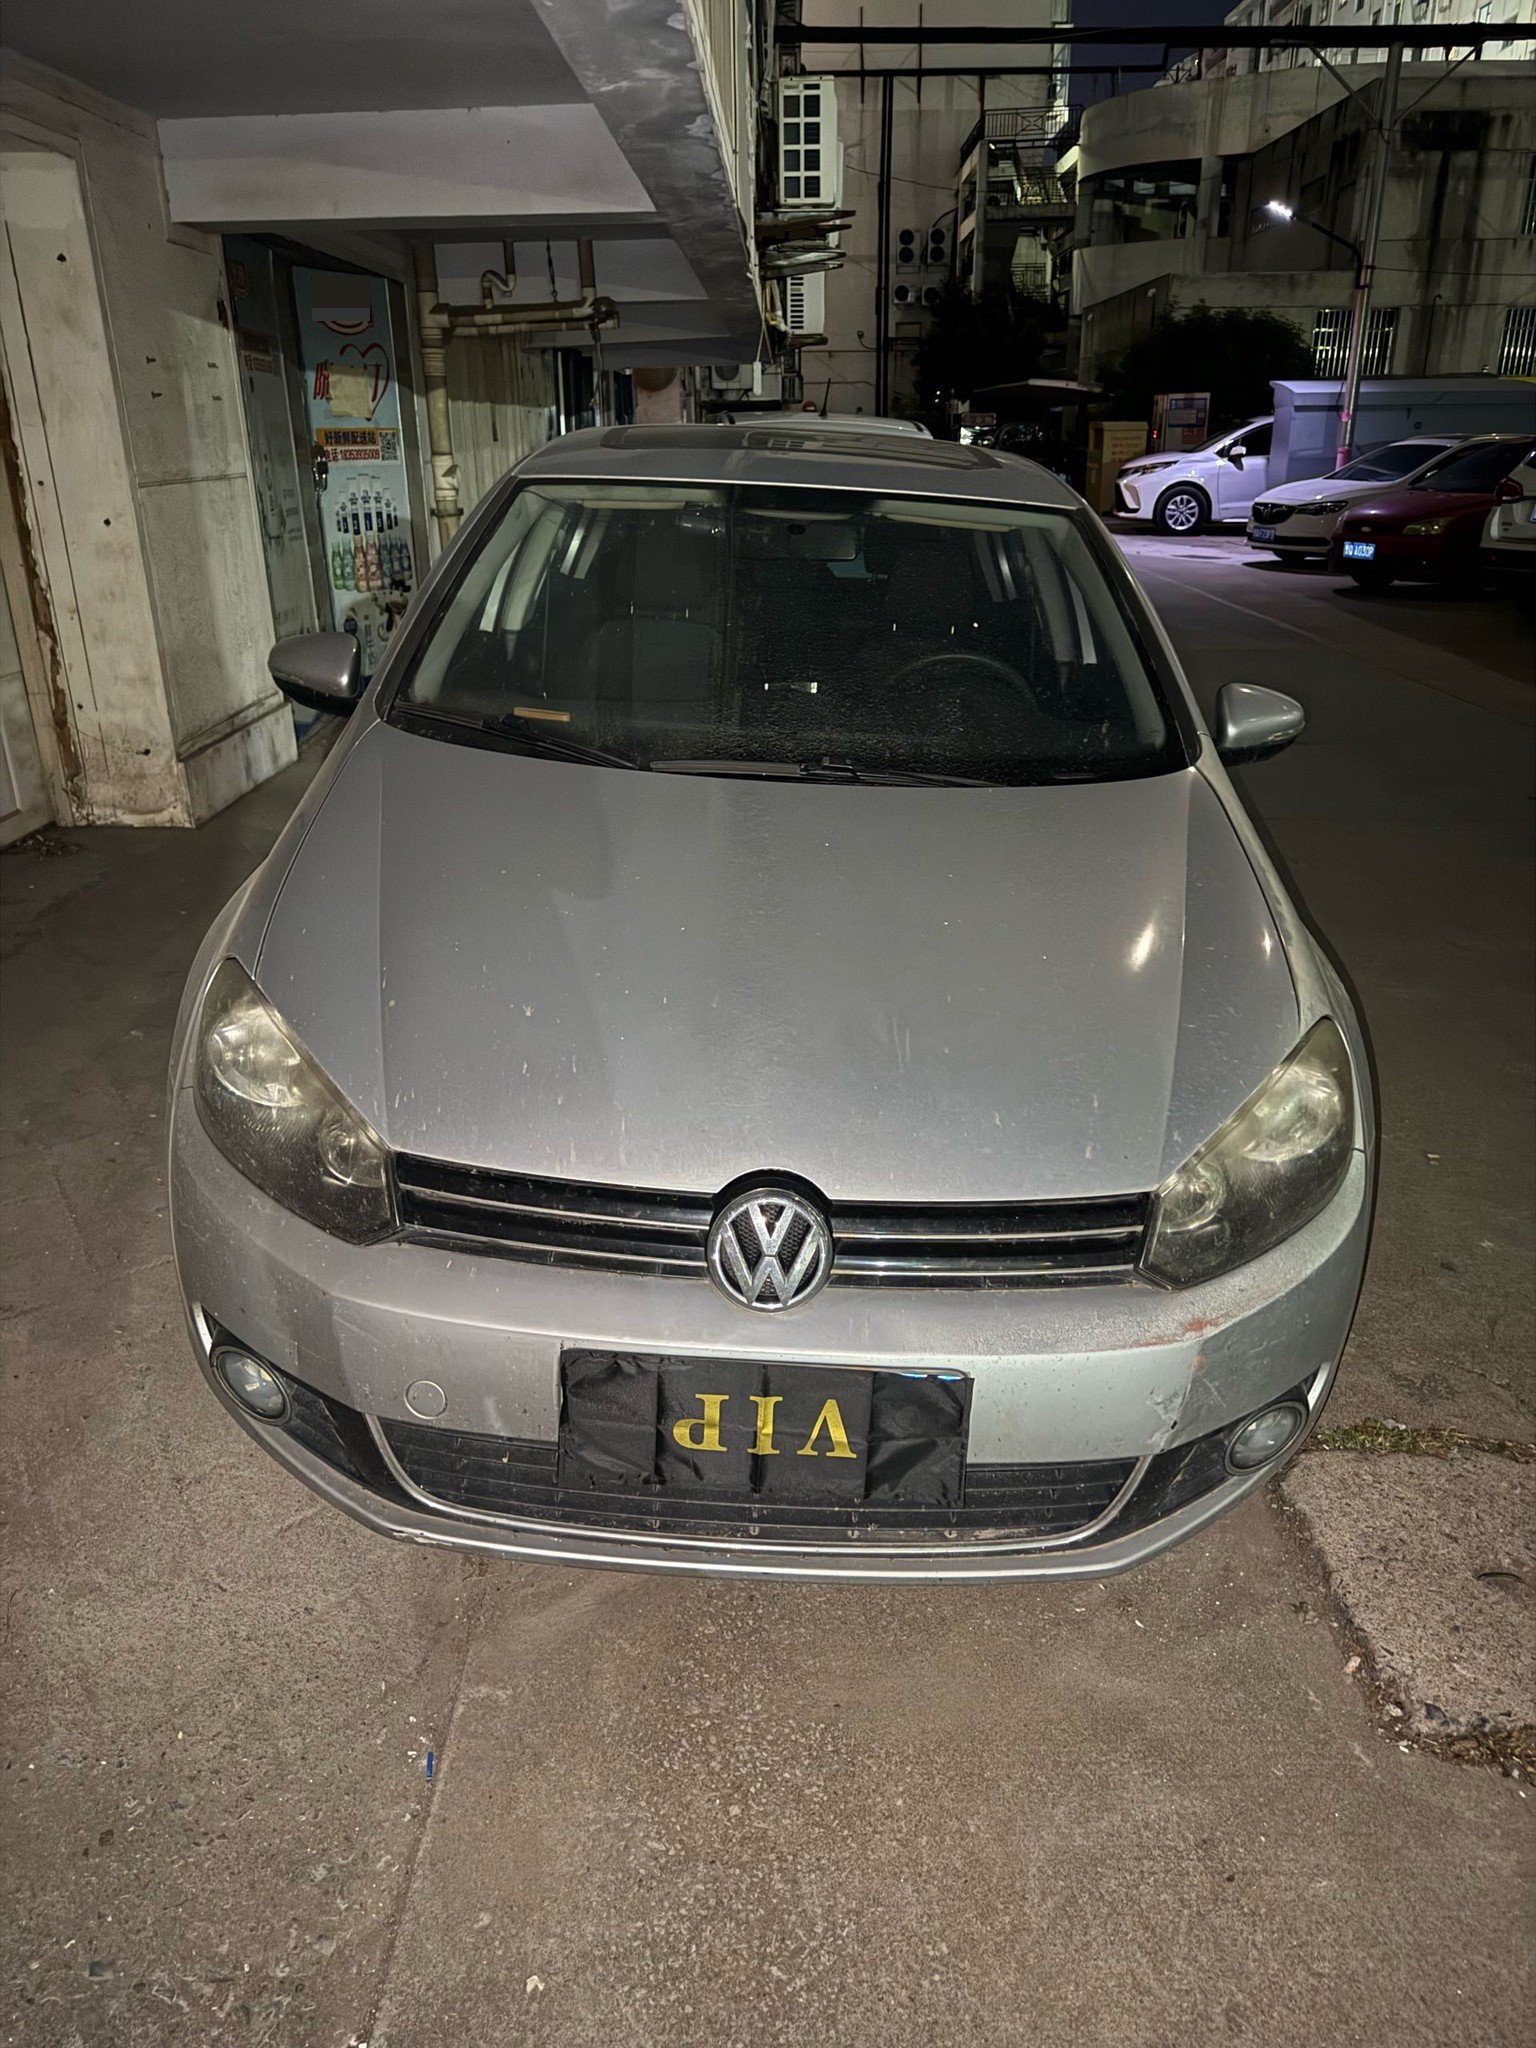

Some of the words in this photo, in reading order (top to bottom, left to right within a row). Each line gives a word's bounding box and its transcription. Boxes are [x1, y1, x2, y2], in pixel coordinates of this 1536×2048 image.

[324, 430, 377, 446] 好新鲜配送站
[672, 1393, 857, 1459] VIP
